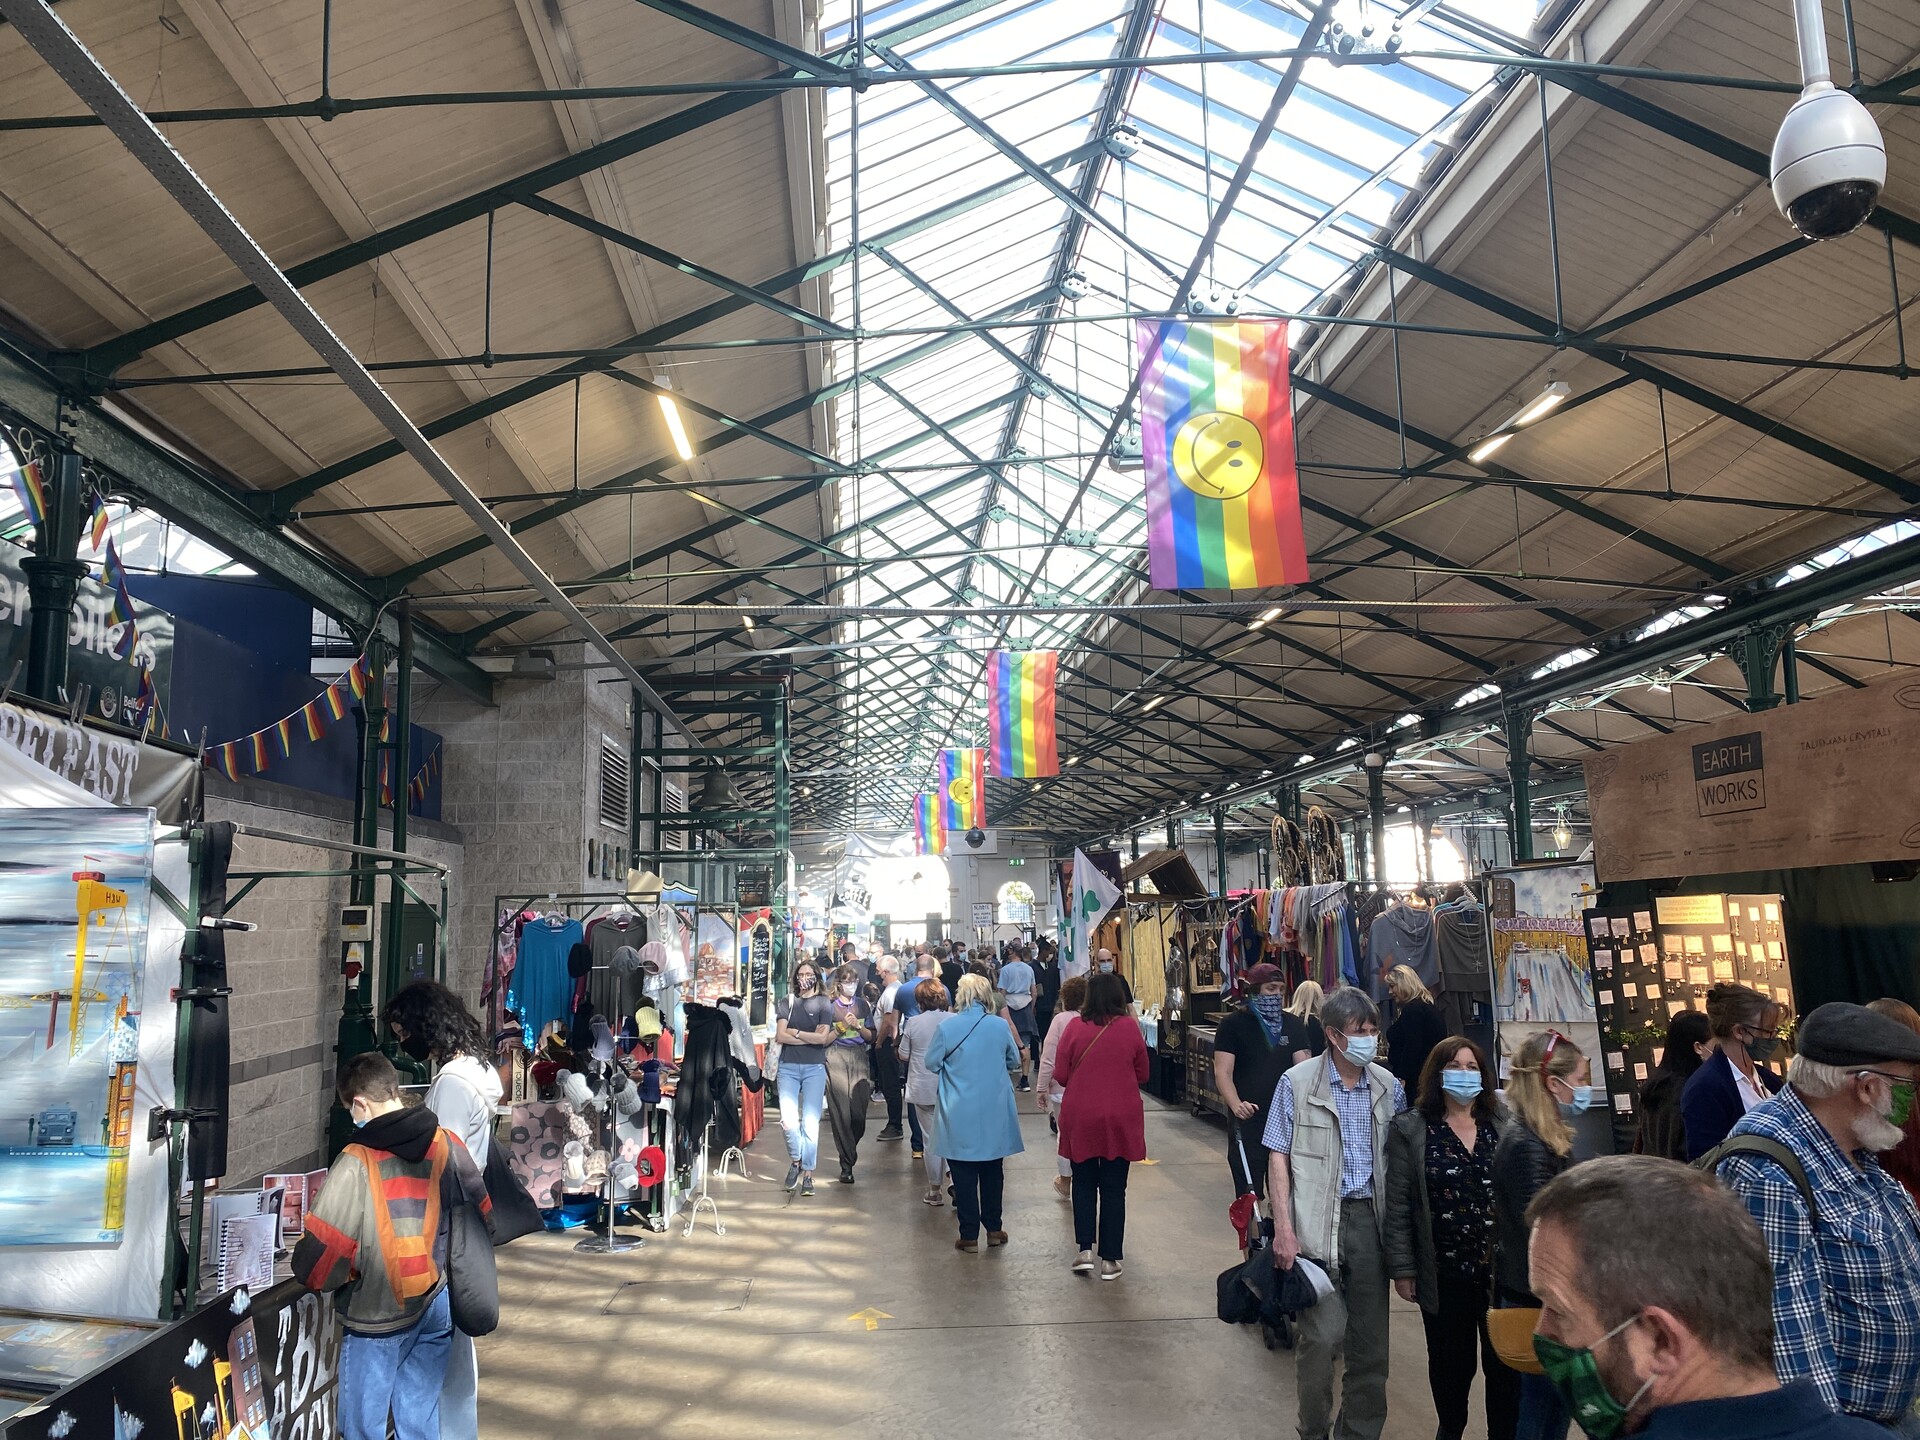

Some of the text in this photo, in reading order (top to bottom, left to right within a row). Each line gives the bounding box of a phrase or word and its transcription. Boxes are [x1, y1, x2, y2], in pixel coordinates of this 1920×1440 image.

[1702, 743, 1752, 773] EARTH
[1640, 769, 1670, 785] BANSHEE
[1702, 778, 1758, 807] WORKS
